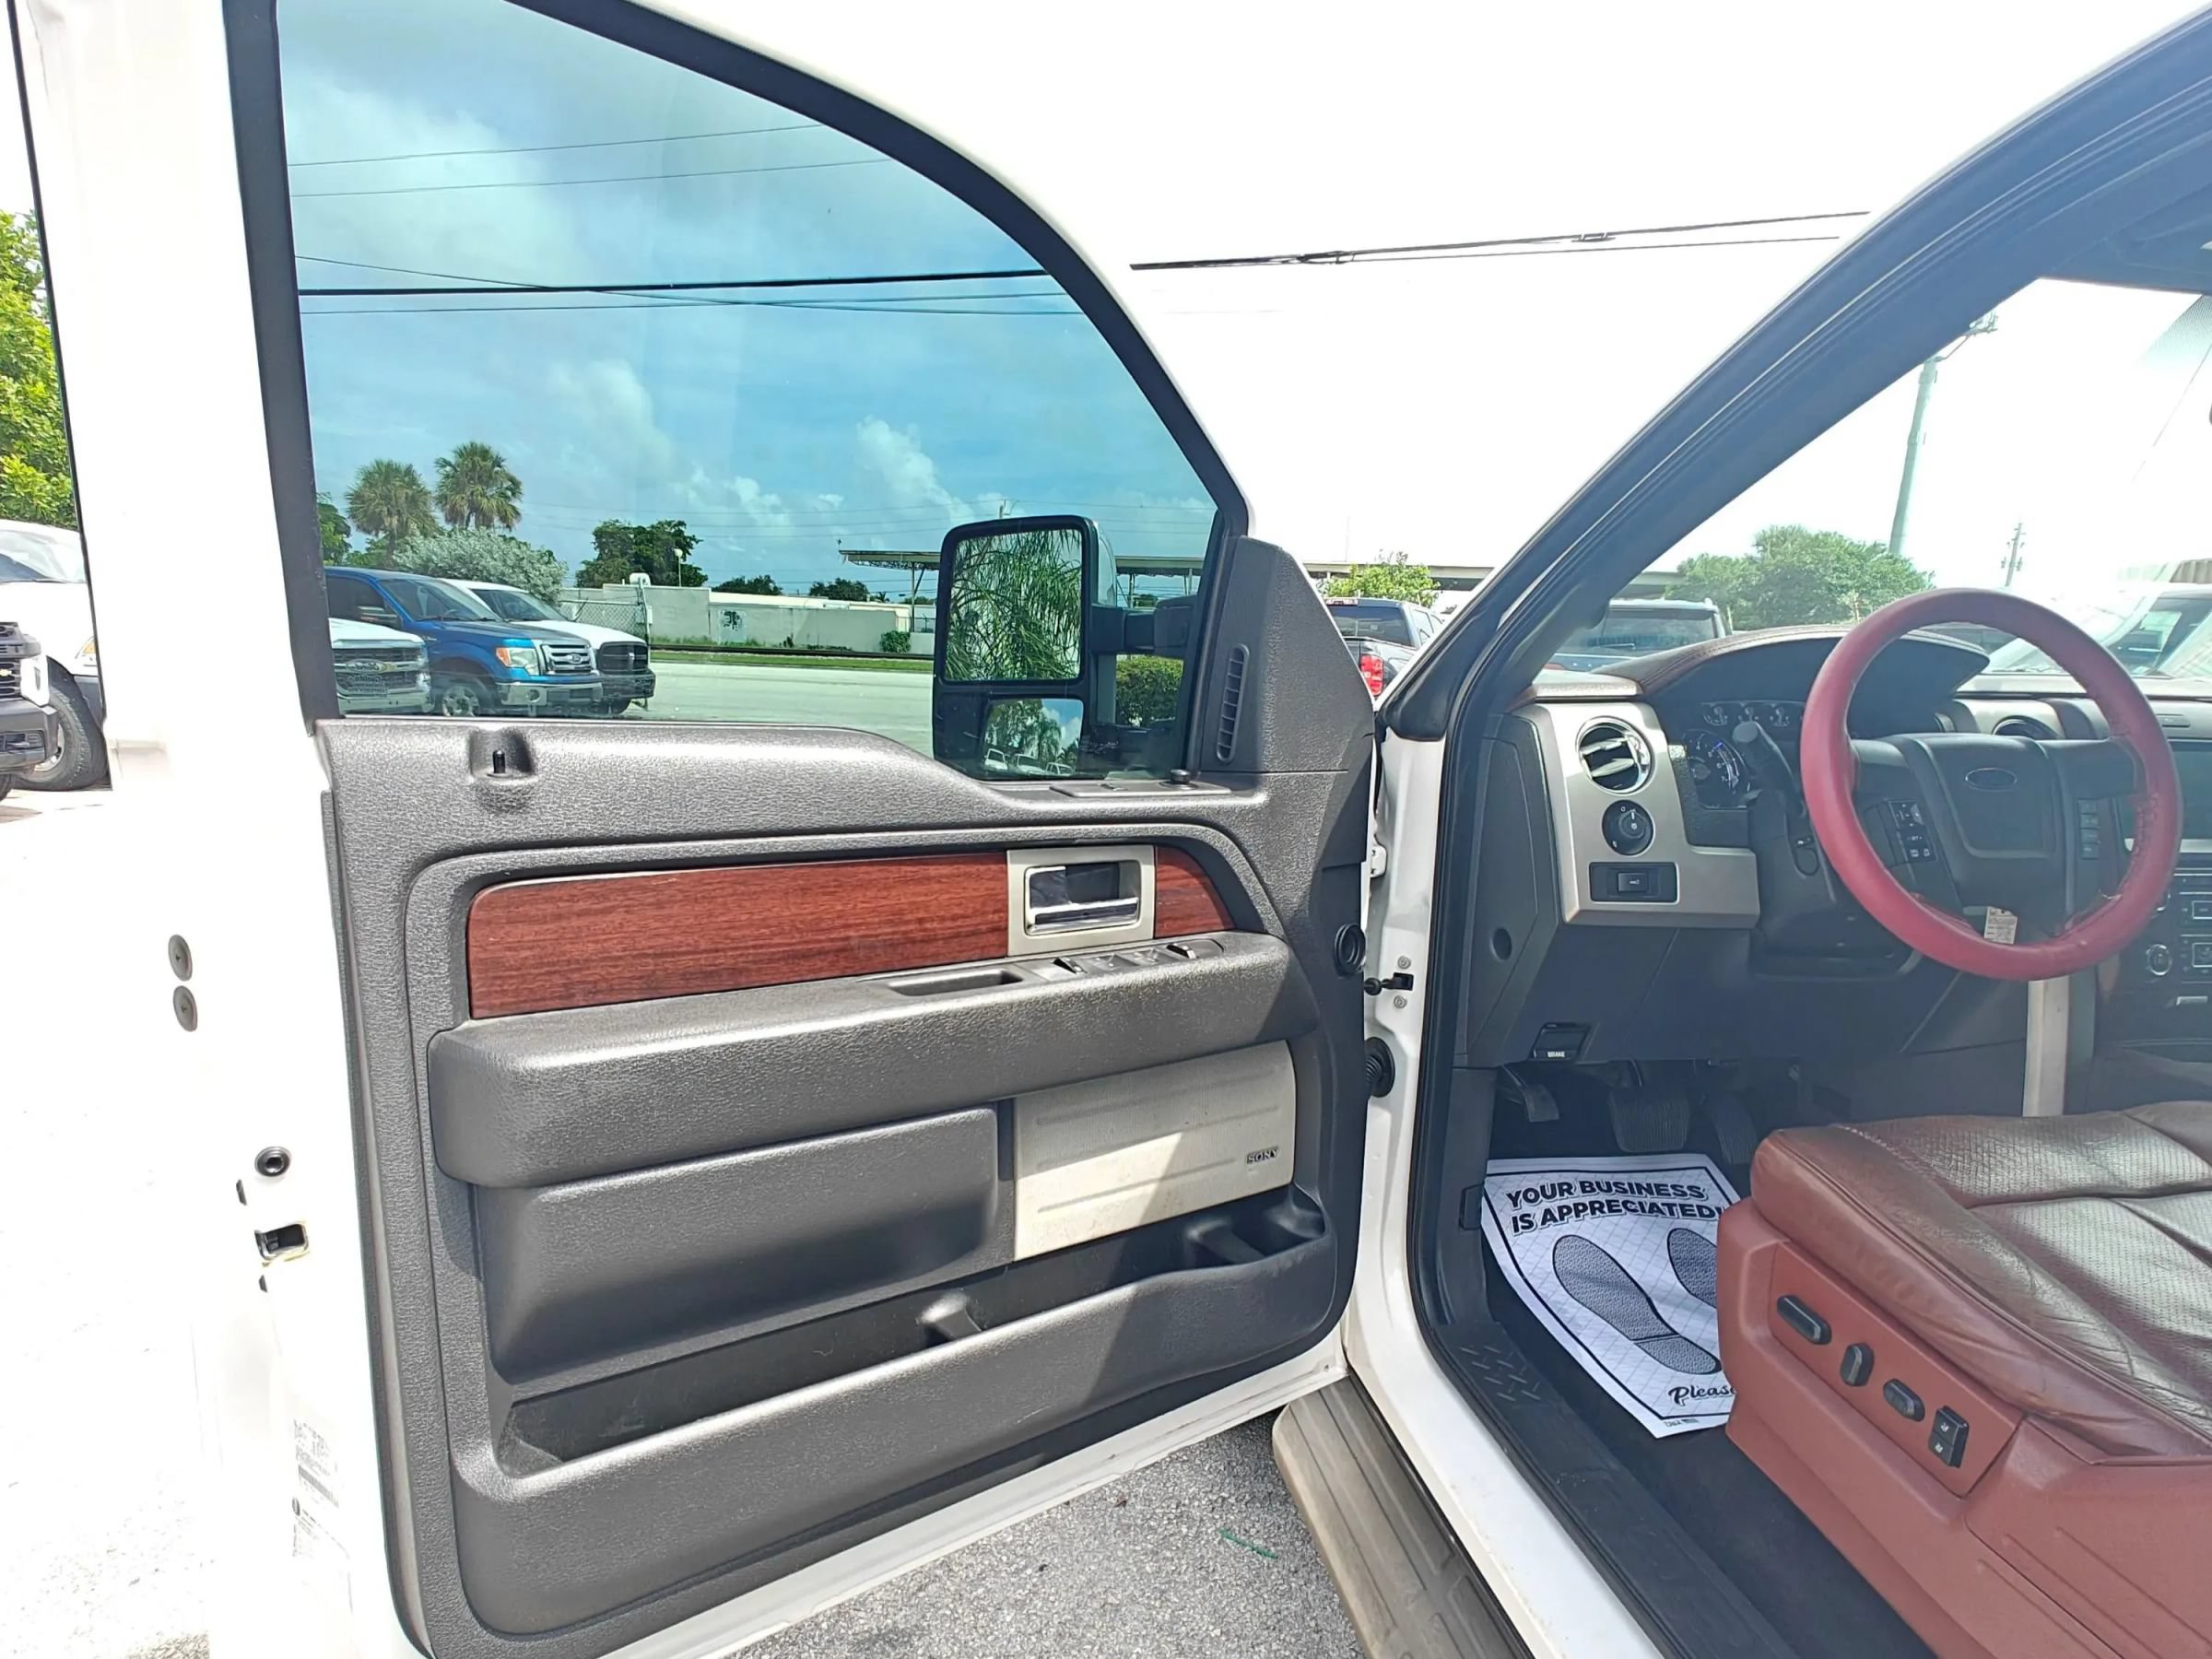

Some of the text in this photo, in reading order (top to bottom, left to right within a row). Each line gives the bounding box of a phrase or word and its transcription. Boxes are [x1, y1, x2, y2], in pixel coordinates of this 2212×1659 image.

[1247, 1147, 1278, 1164] SONY
[1507, 1181, 1707, 1209] YOUR BUSINESS
[1512, 1210, 1536, 1233] IS
